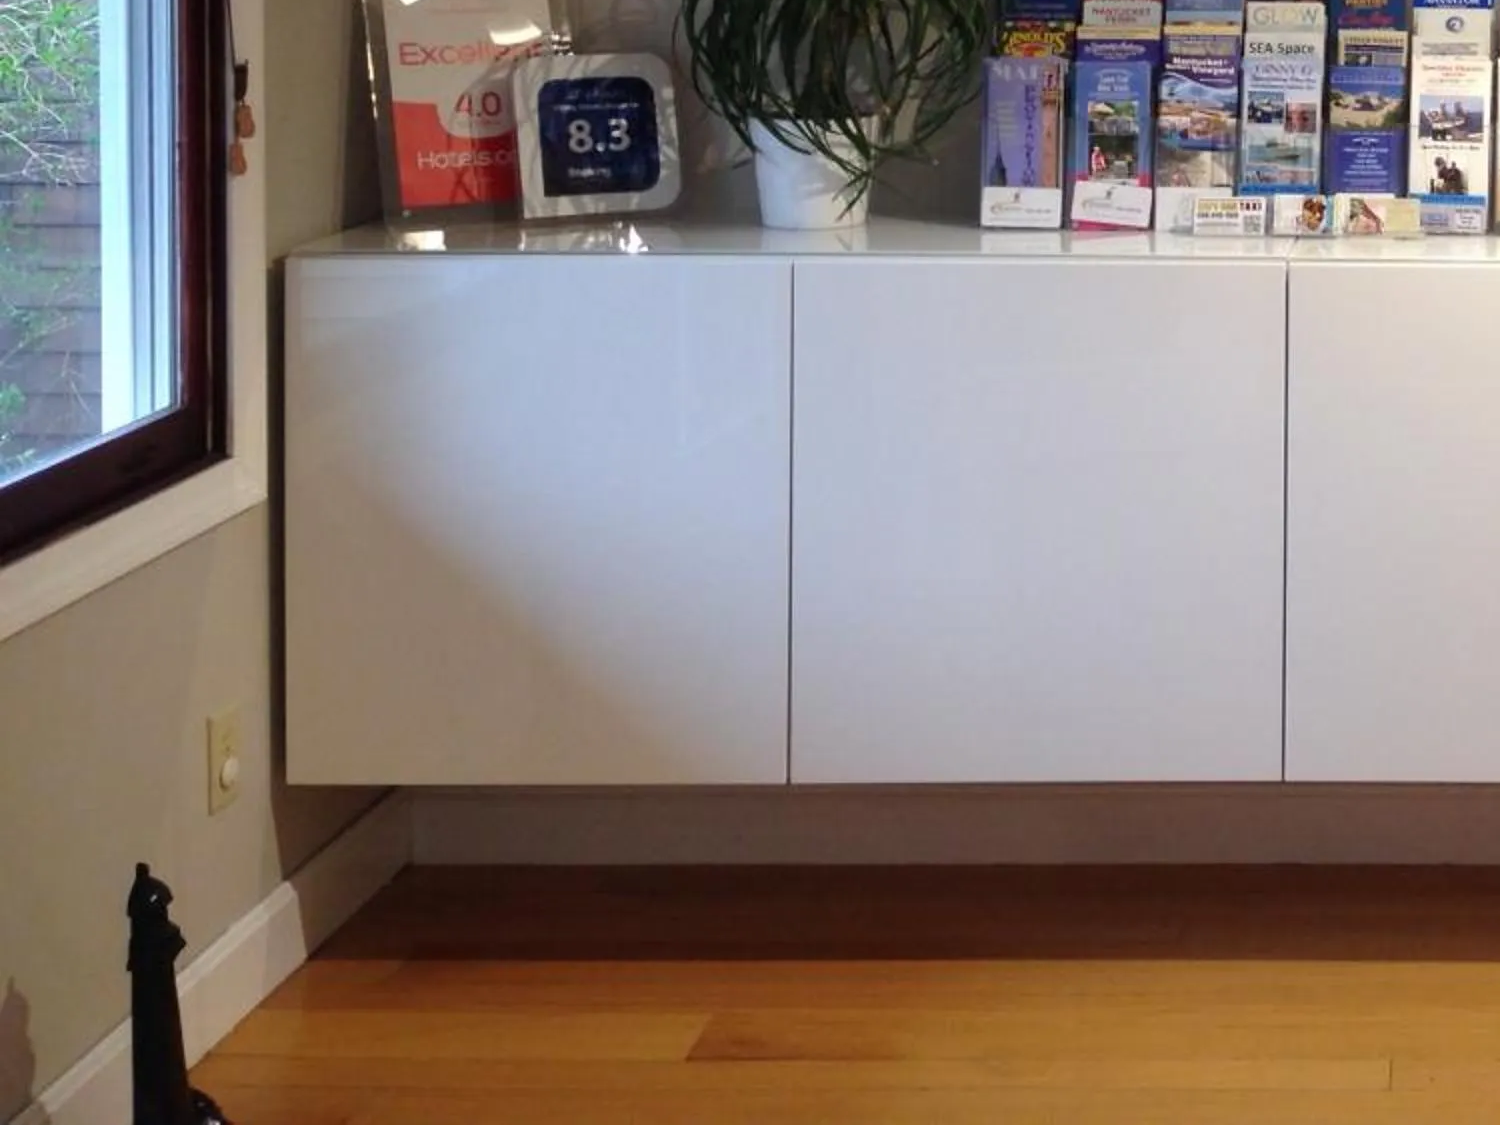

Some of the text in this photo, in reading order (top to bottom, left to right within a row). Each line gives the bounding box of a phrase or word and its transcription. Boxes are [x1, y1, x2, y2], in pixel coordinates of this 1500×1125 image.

[1252, 6, 1319, 25] GLOW
[1249, 42, 1316, 55] SEA Space
[454, 90, 503, 117] 4.0
[568, 118, 632, 154] 8.3
